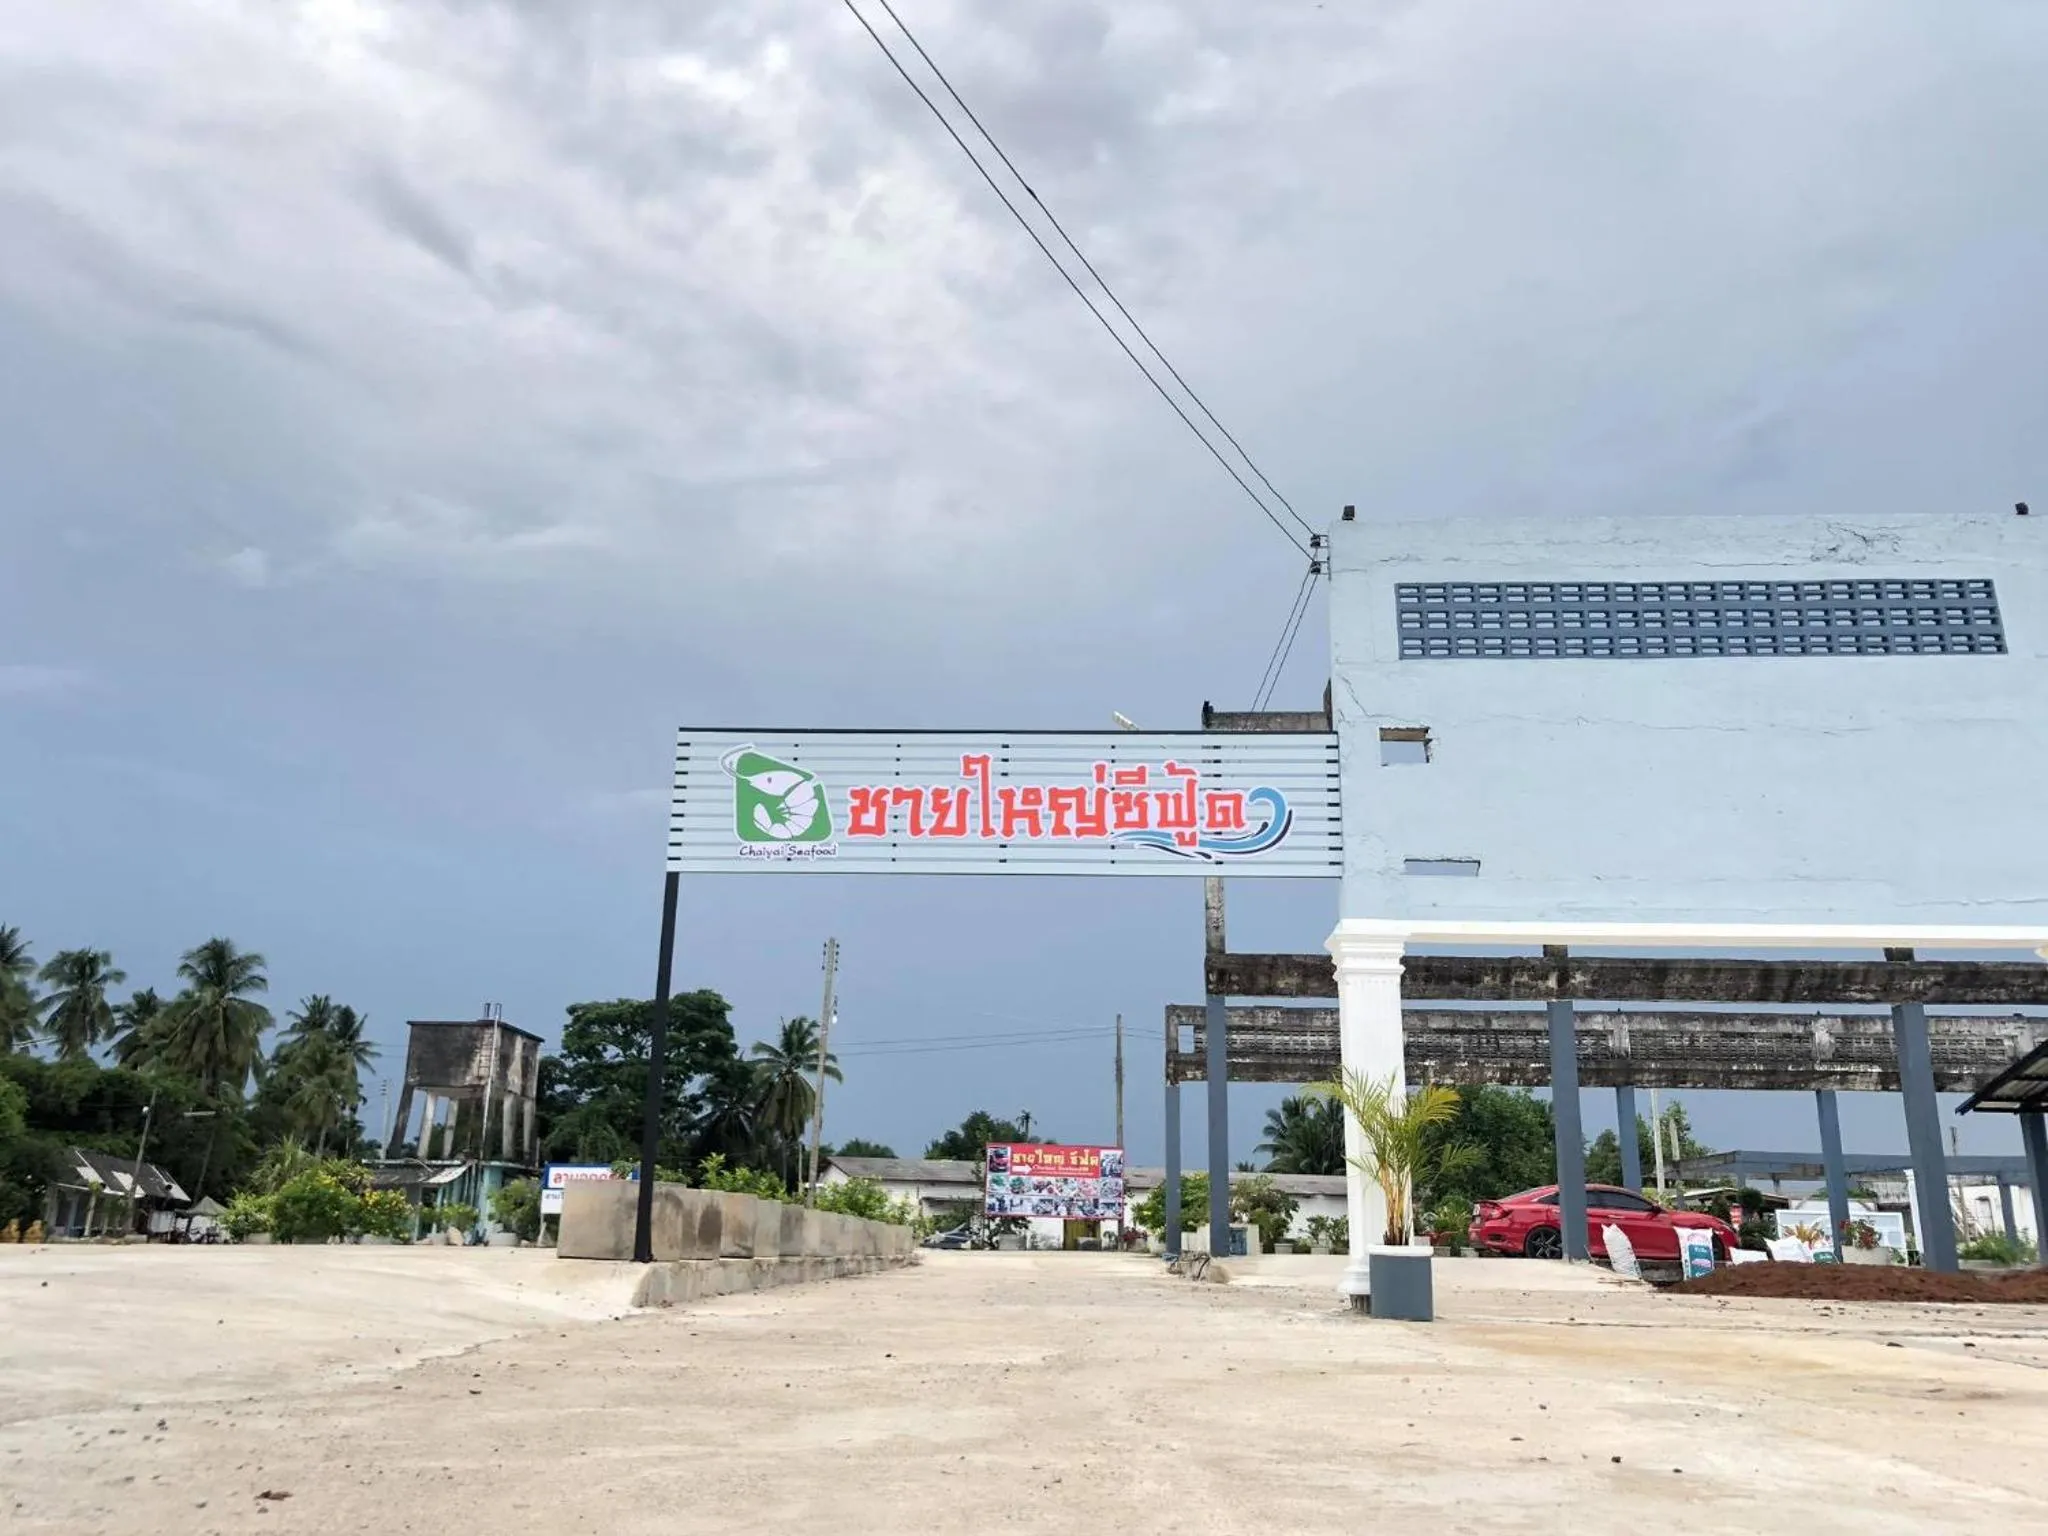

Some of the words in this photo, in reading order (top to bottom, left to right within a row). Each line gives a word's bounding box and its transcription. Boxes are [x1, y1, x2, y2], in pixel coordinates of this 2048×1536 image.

[848, 754, 1246, 847] ชายใหญ่ซีฟู้ด
[739, 845, 784, 859] Chaiyai
[788, 845, 837, 859] Seafood
